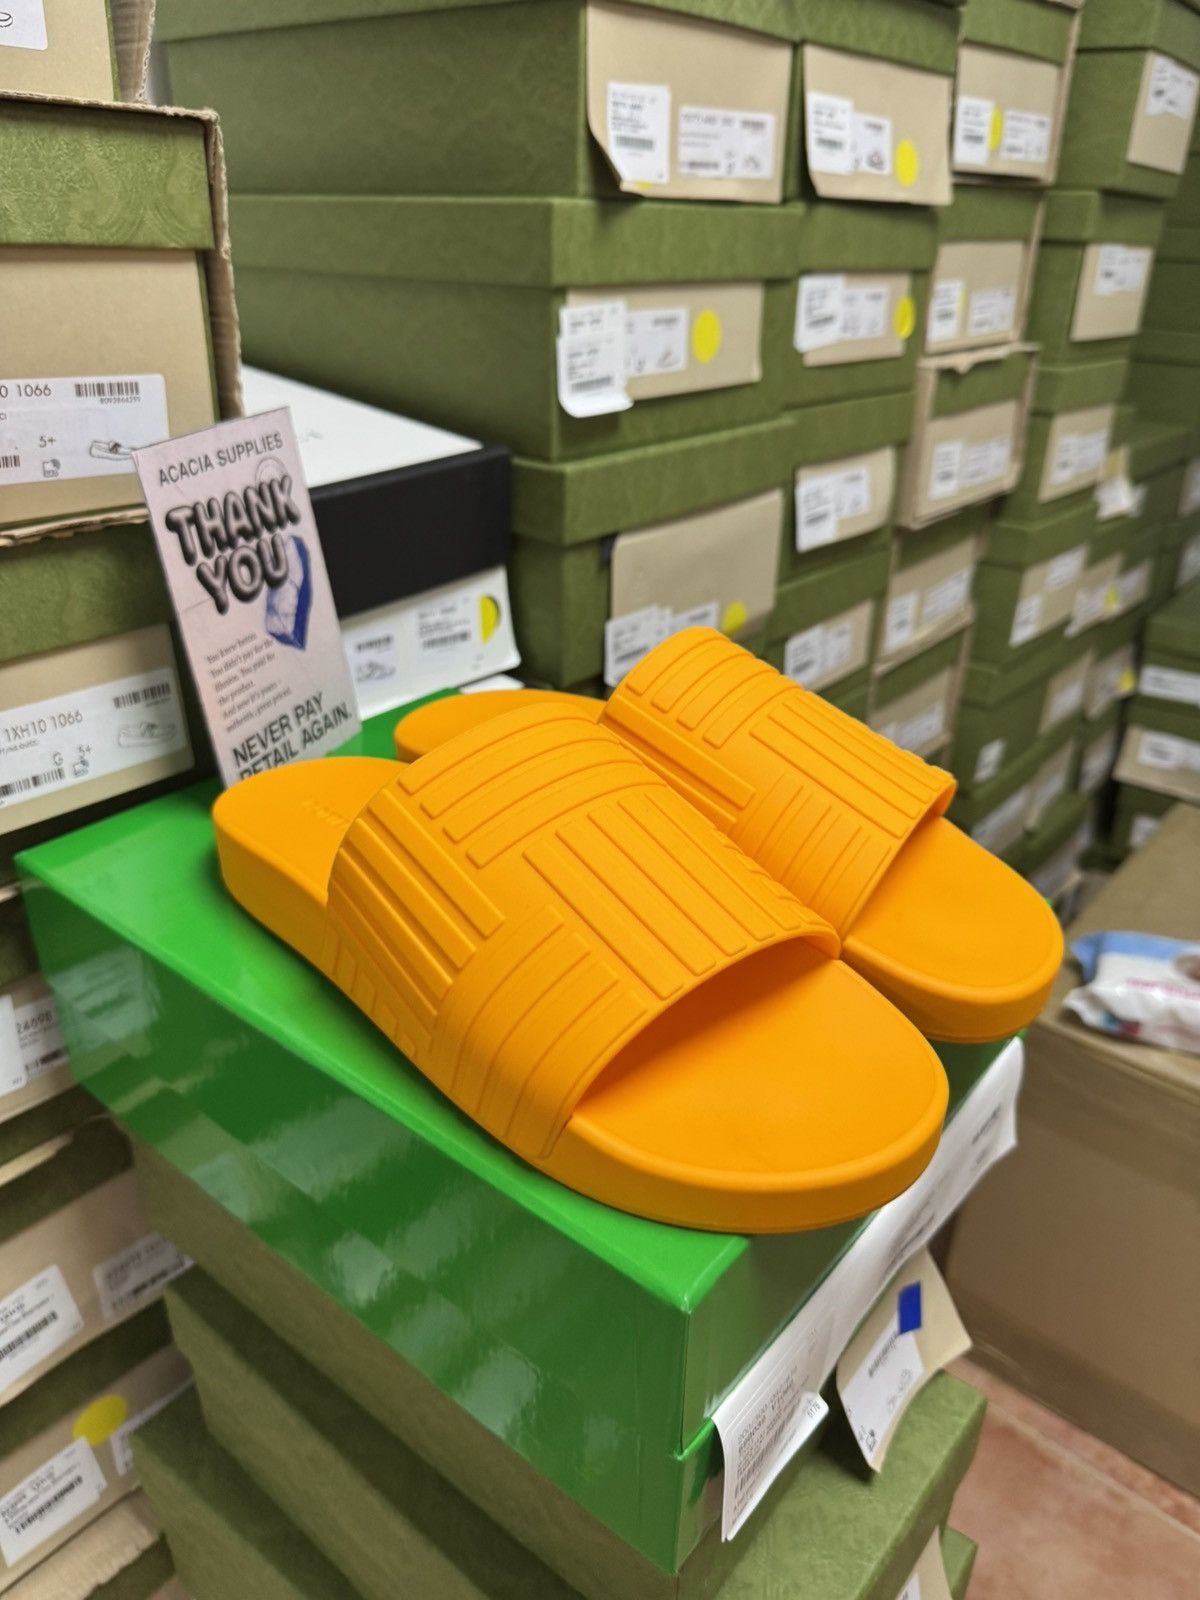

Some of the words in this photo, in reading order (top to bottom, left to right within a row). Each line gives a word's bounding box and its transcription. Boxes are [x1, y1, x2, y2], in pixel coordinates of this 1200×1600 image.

[17, 384, 52, 397] 1066
[159, 454, 215, 487] ACACIA
[216, 432, 284, 468] SUPPLIES
[165, 474, 300, 567] THANK
[196, 533, 289, 615] YOU
[4, 718, 47, 742] 1XH10
[51, 709, 83, 729] 1066
[232, 713, 292, 768] NEVER
[294, 690, 323, 727] PAY
[301, 701, 352, 750] AGAIN.
